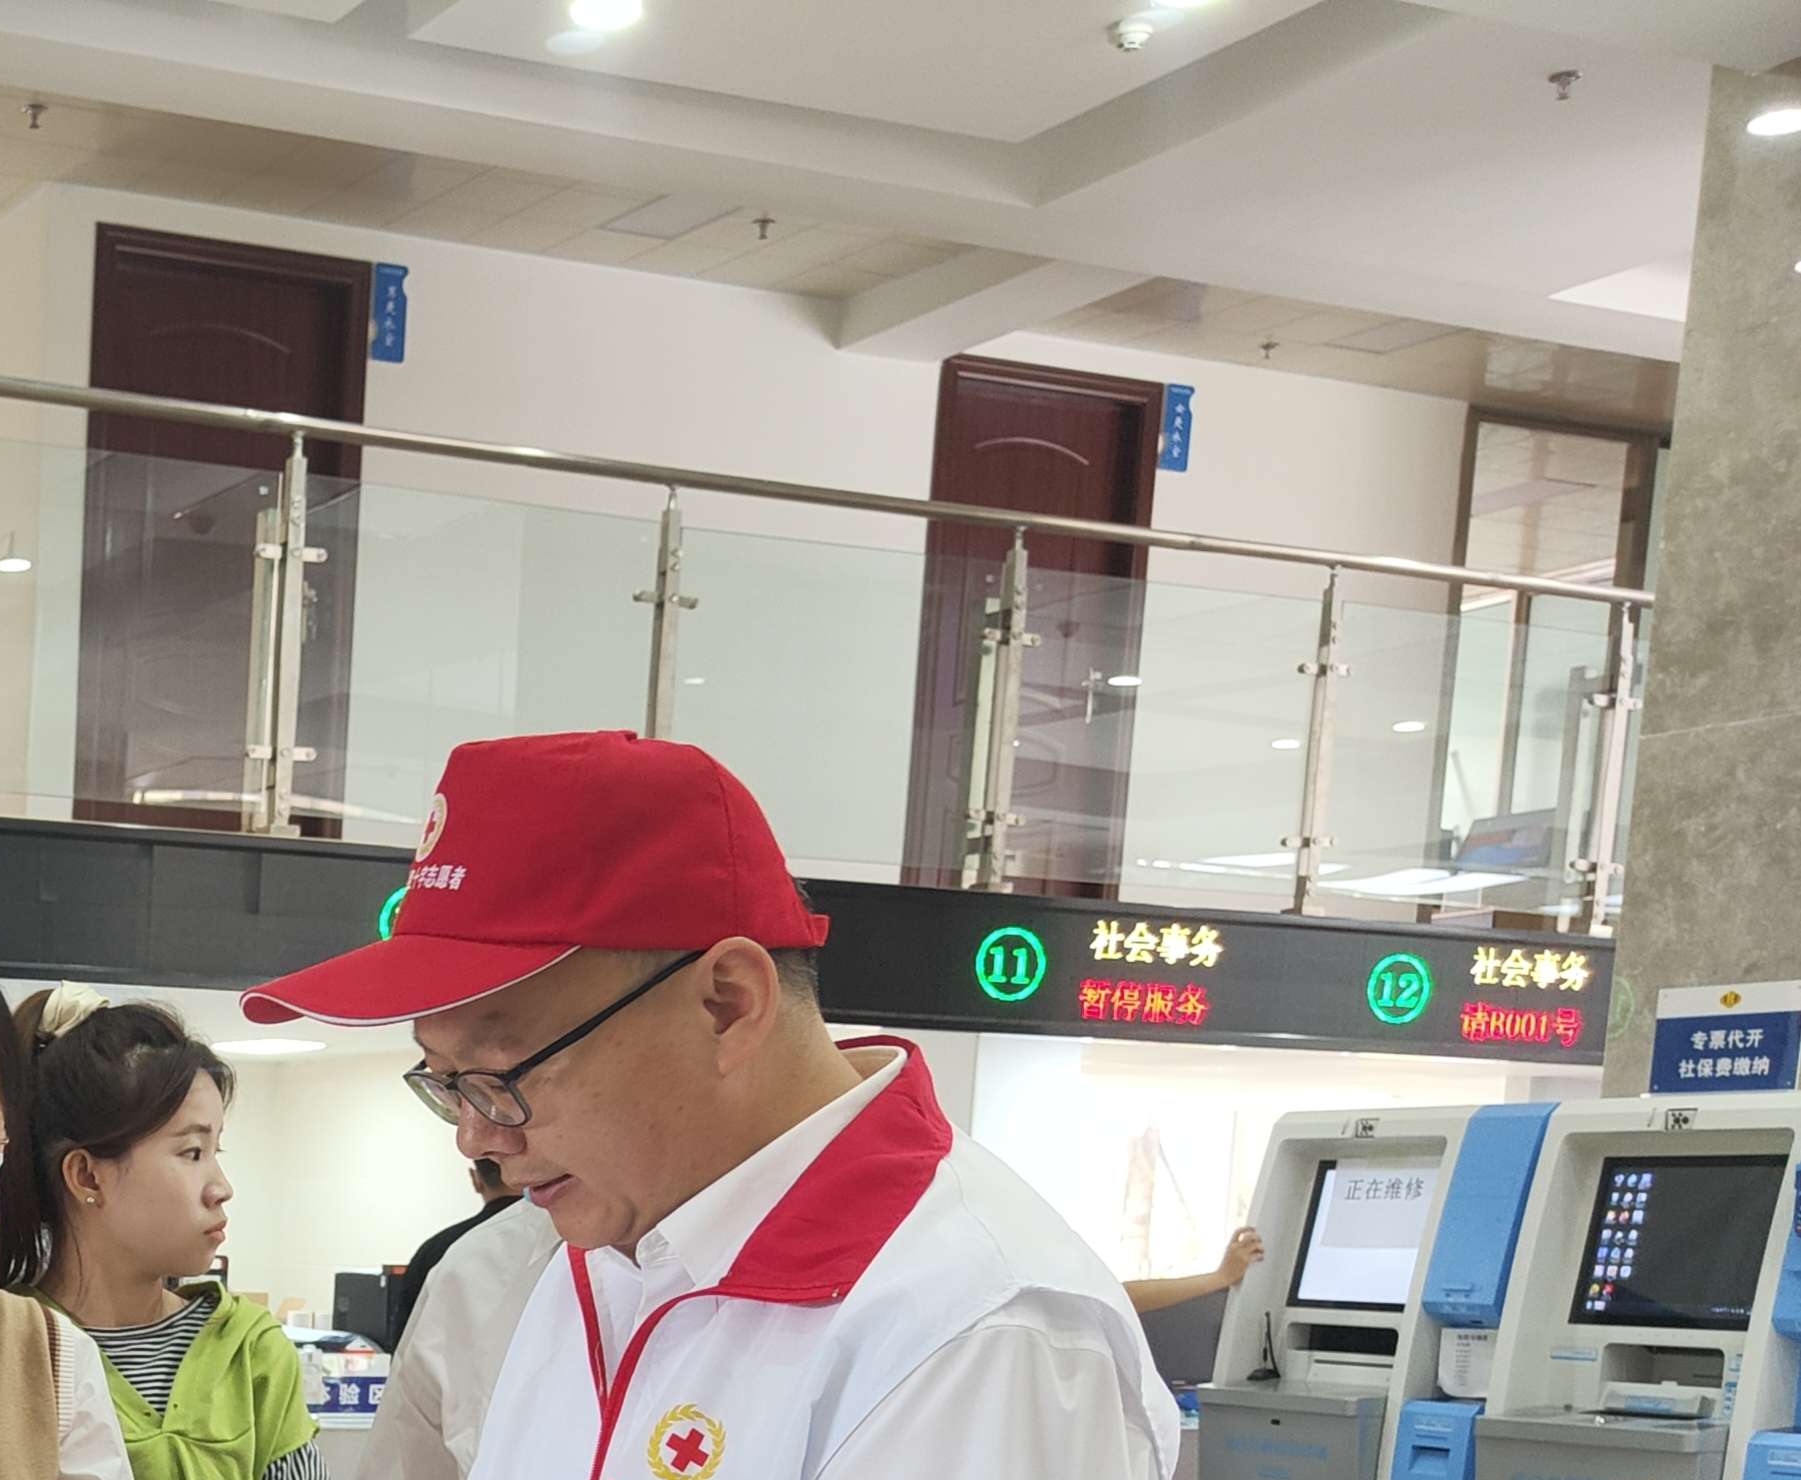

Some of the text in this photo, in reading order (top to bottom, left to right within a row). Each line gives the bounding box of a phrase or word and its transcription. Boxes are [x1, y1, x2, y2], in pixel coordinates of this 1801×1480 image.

[1090, 919, 1224, 968] 社会事务
[1470, 946, 1591, 992] 社会事务
[1078, 977, 1209, 1026] 暂停服务
[1460, 1001, 1583, 1048] 请B001号
[1690, 1029, 1764, 1050] 专票代开
[1678, 1056, 1770, 1079] 社保费缴纳
[1344, 1177, 1425, 1201] 正在维修
[324, 1383, 385, 1405] 验区
